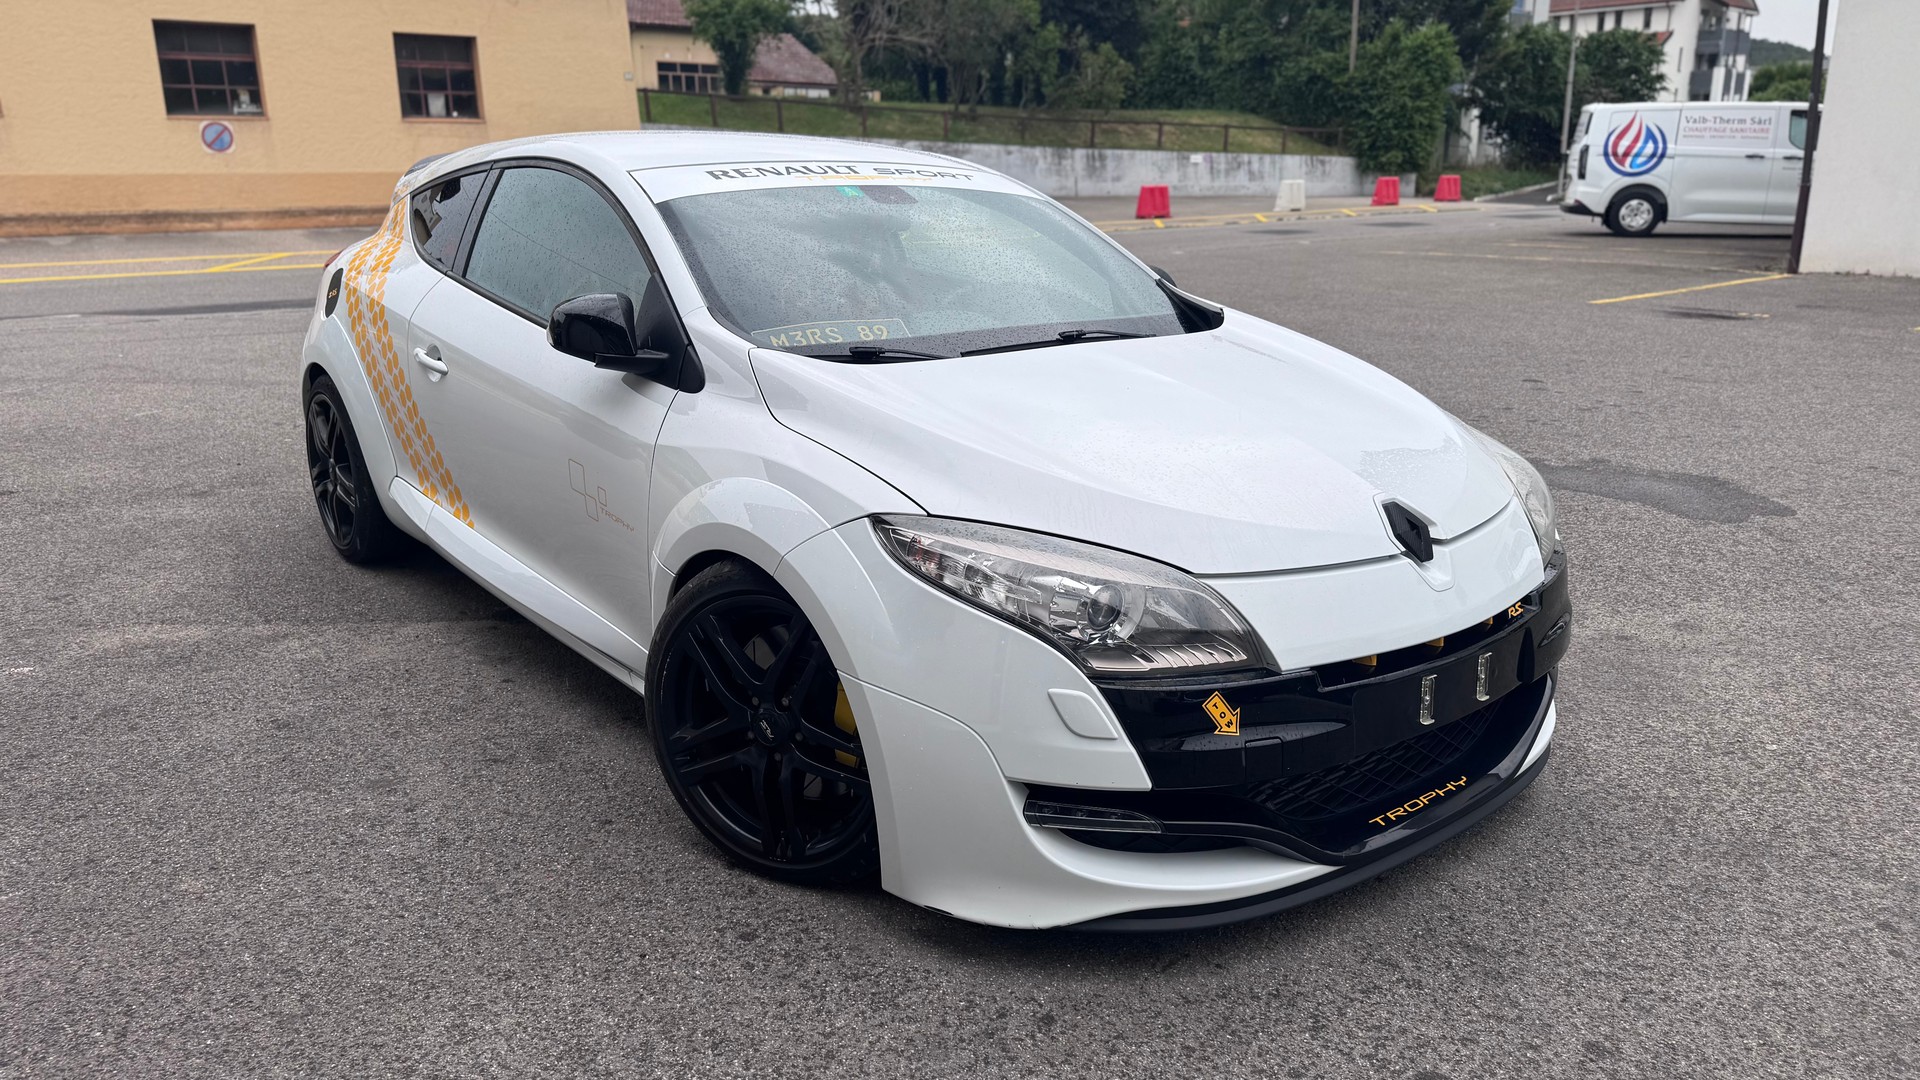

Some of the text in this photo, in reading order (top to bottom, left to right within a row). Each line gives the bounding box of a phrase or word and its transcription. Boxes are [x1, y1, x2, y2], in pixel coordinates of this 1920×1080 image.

[1685, 116, 1747, 125] Valb-Therm
[704, 165, 974, 181] RENAULT SPORT
[769, 325, 888, 347] M3RS 89
[599, 506, 635, 532] TROPHY
[1211, 701, 1234, 729] TOW
[1368, 775, 1468, 826] TROPHY
